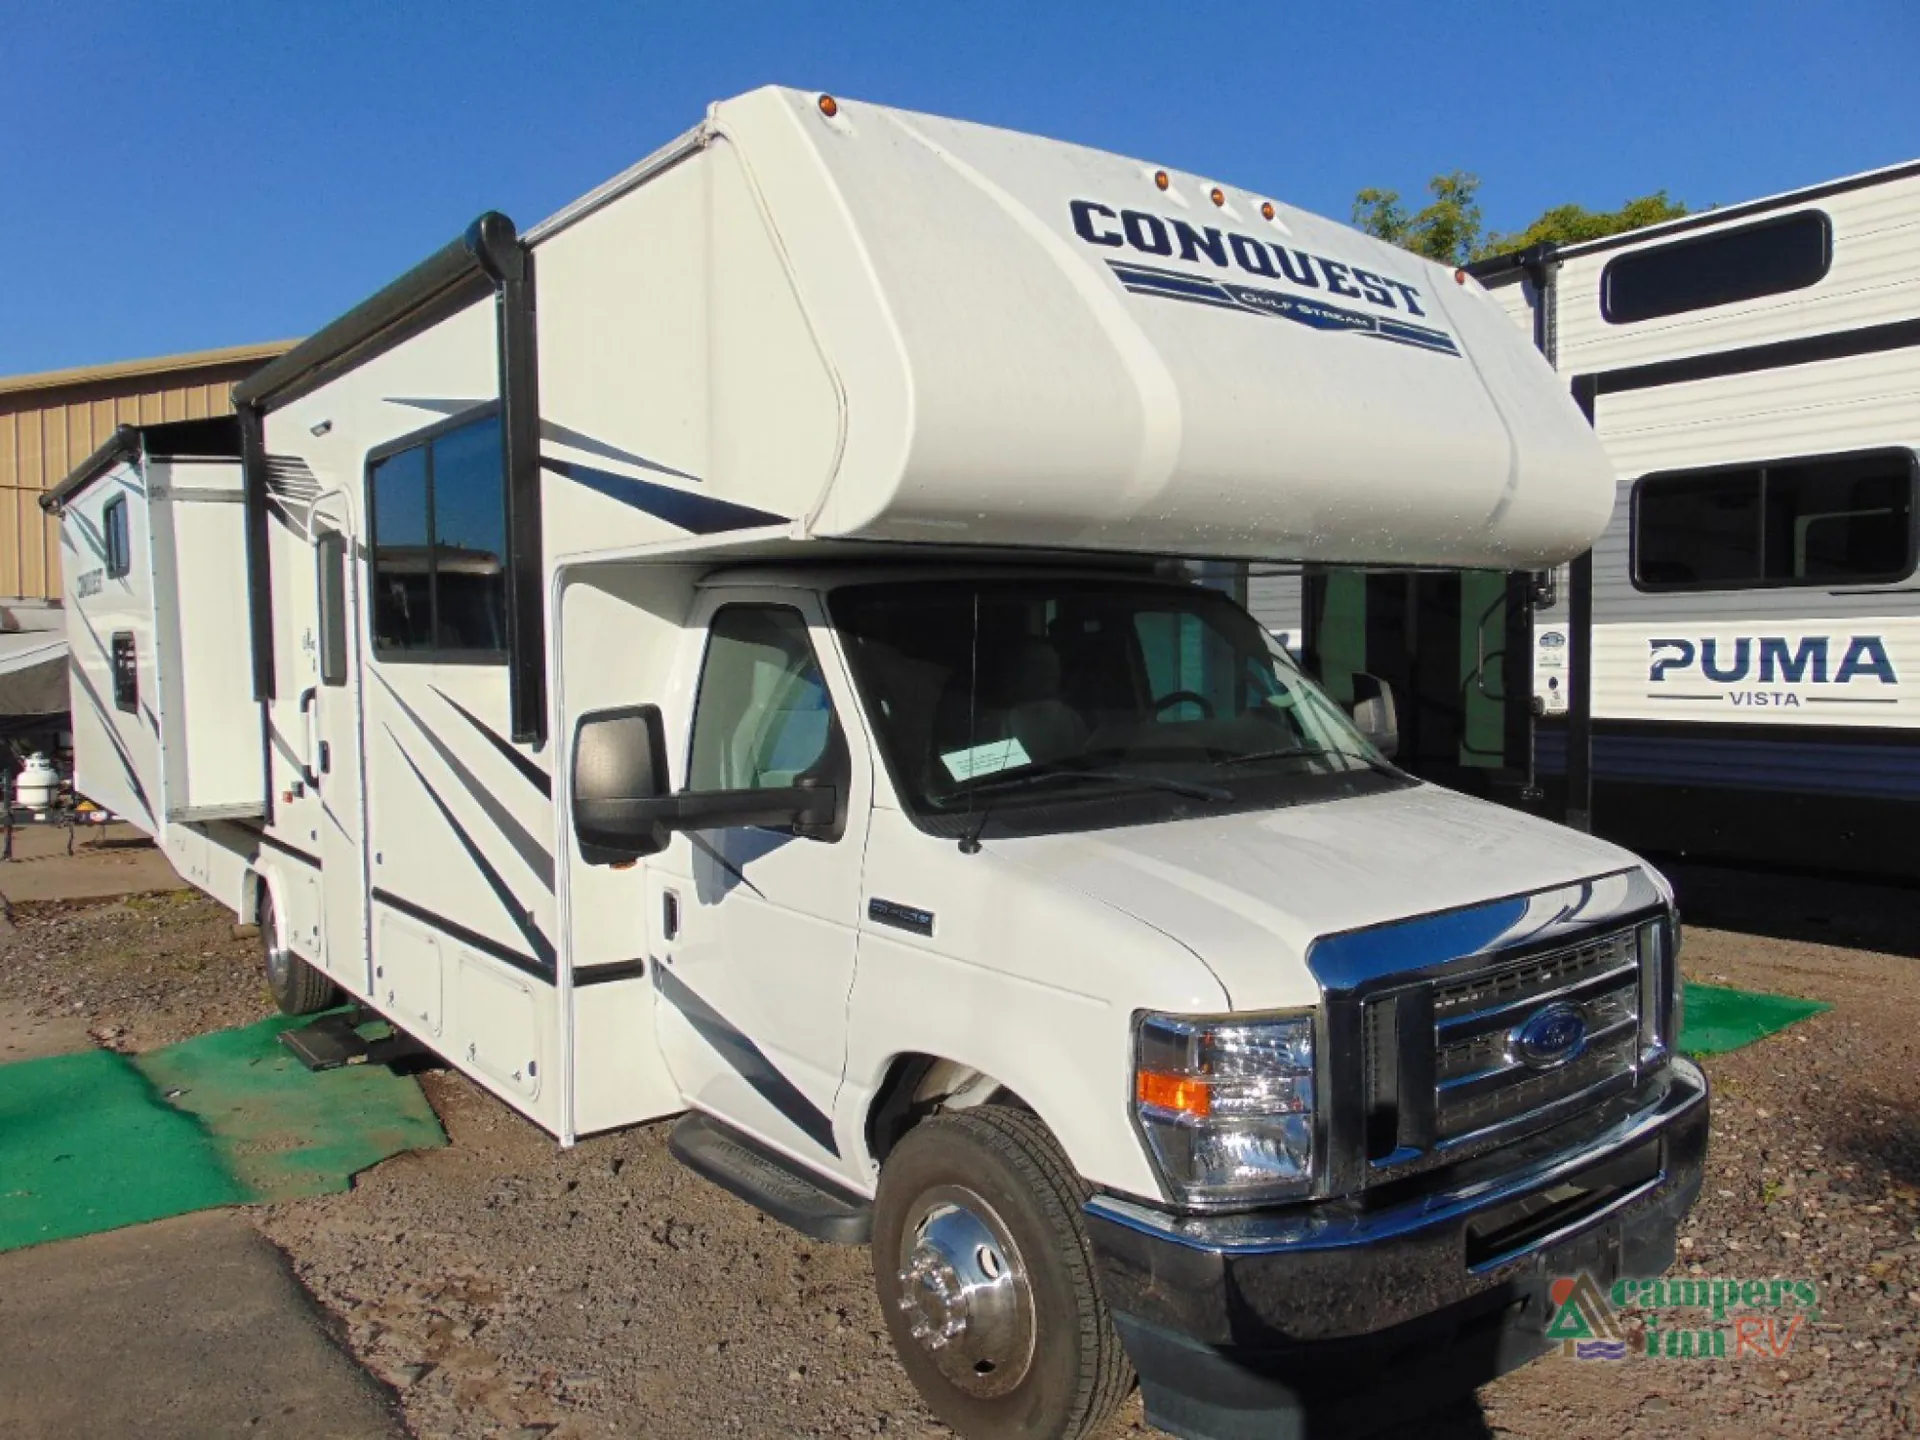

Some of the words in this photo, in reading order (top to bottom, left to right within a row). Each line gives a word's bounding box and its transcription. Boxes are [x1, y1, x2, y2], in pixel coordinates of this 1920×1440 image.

[1070, 199, 1426, 317] CONQUEST
[1648, 636, 1898, 683] PUMA
[1728, 691, 1800, 707] VISTA
